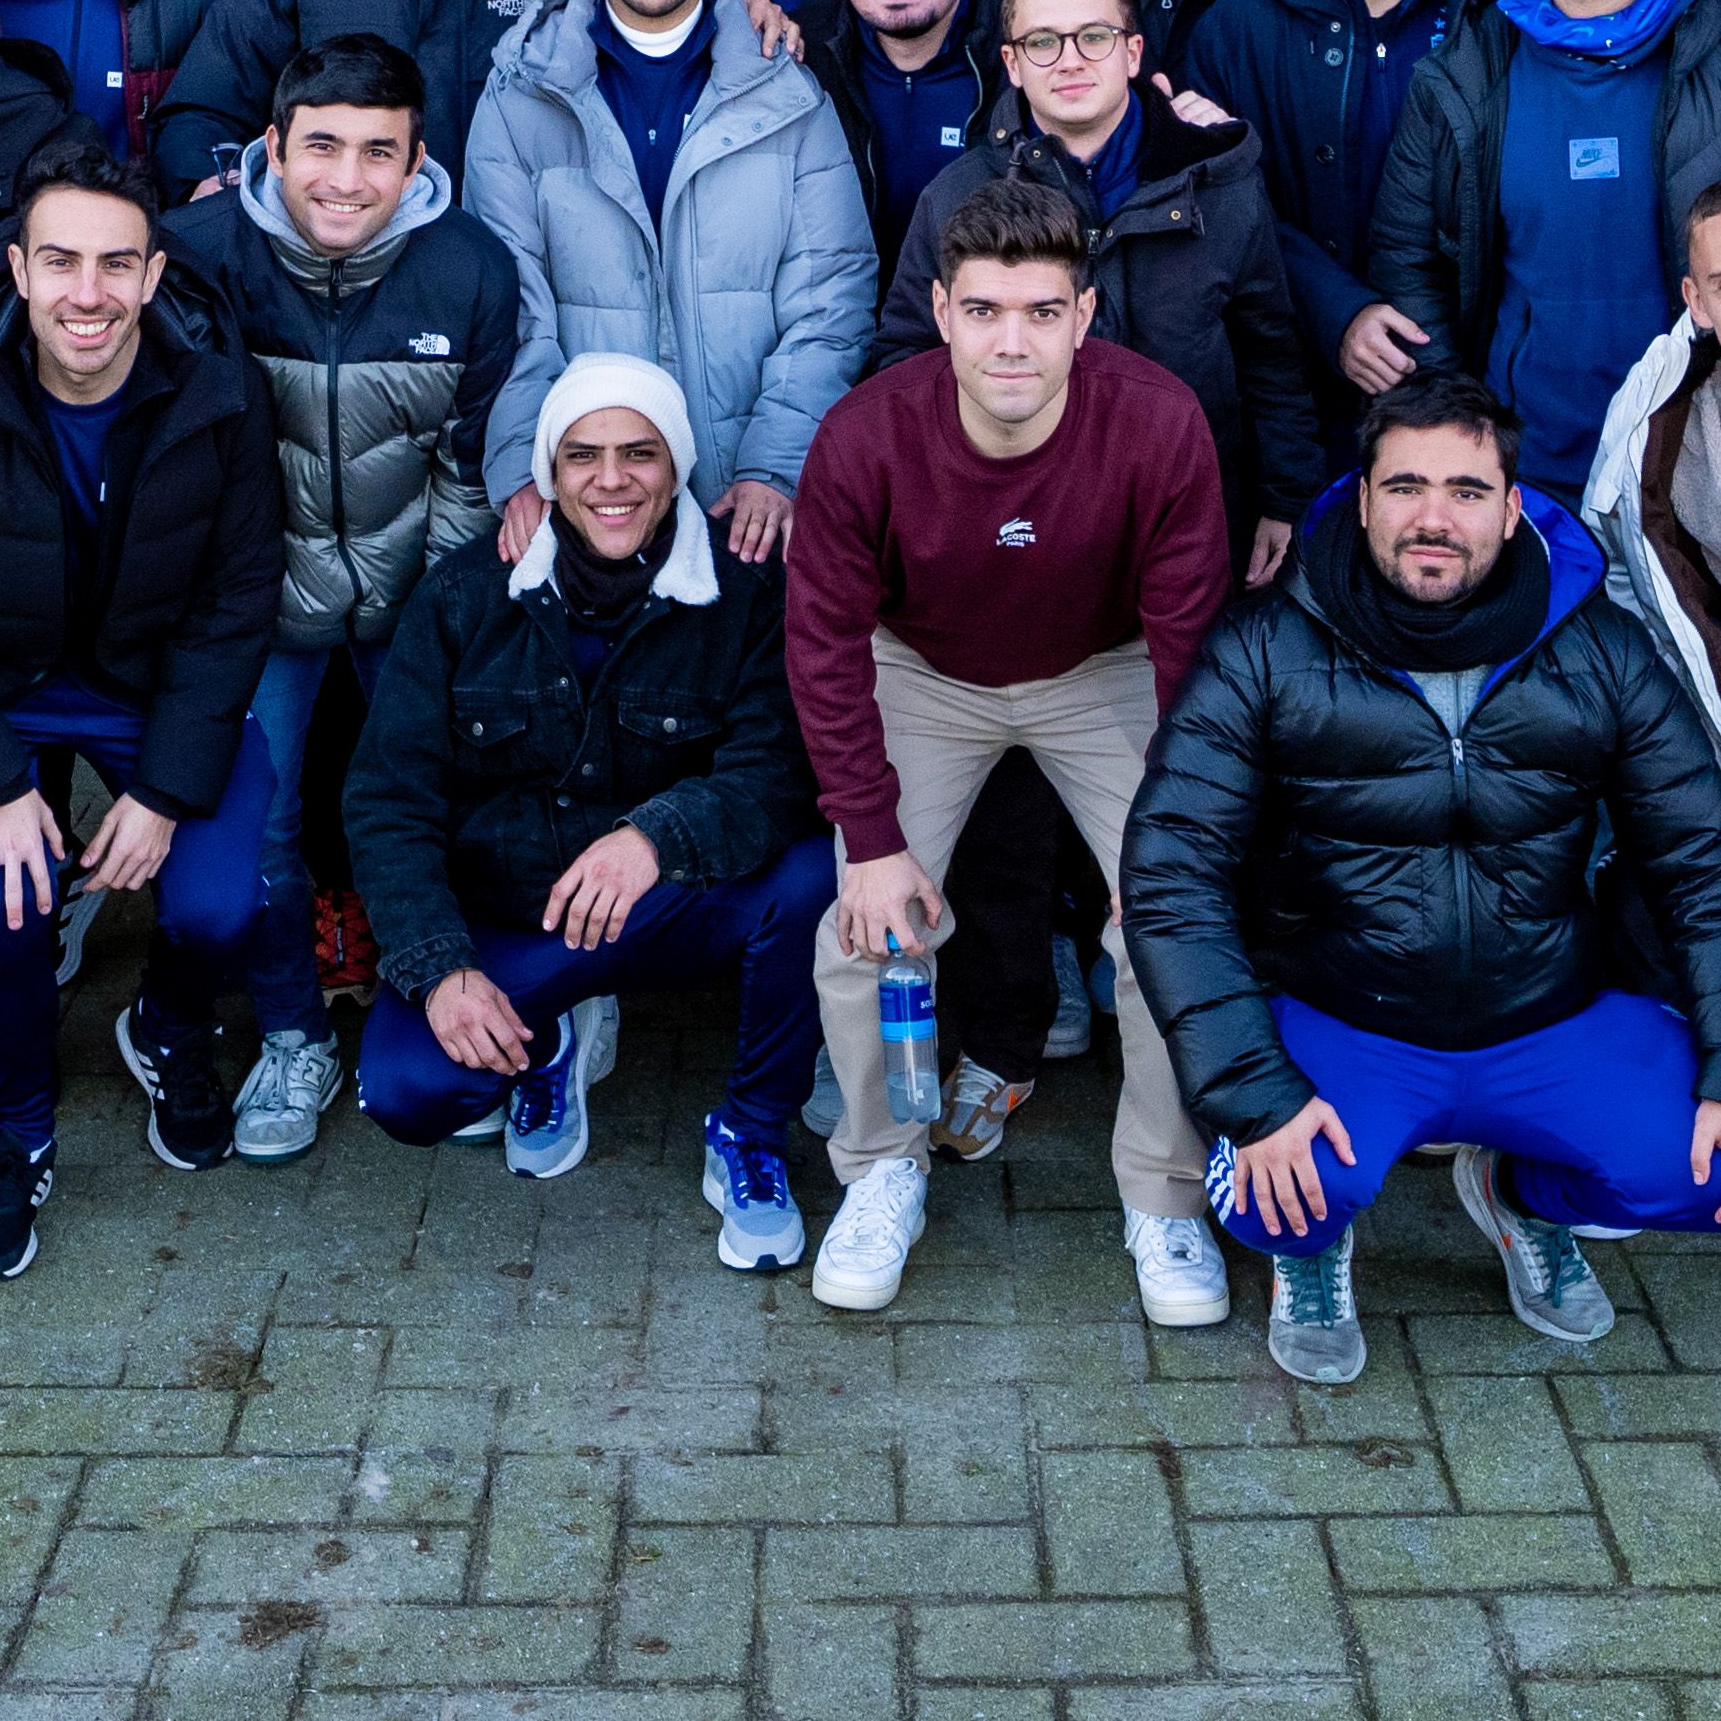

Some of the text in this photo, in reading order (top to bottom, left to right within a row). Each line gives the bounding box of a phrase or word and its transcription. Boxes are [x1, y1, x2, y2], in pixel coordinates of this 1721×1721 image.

[487, 0, 524, 10] NORTH
[498, 8, 526, 17] FACE
[421, 332, 438, 341] THE
[408, 338, 438, 348] NORTH
[996, 533, 1036, 546] LACOSTE
